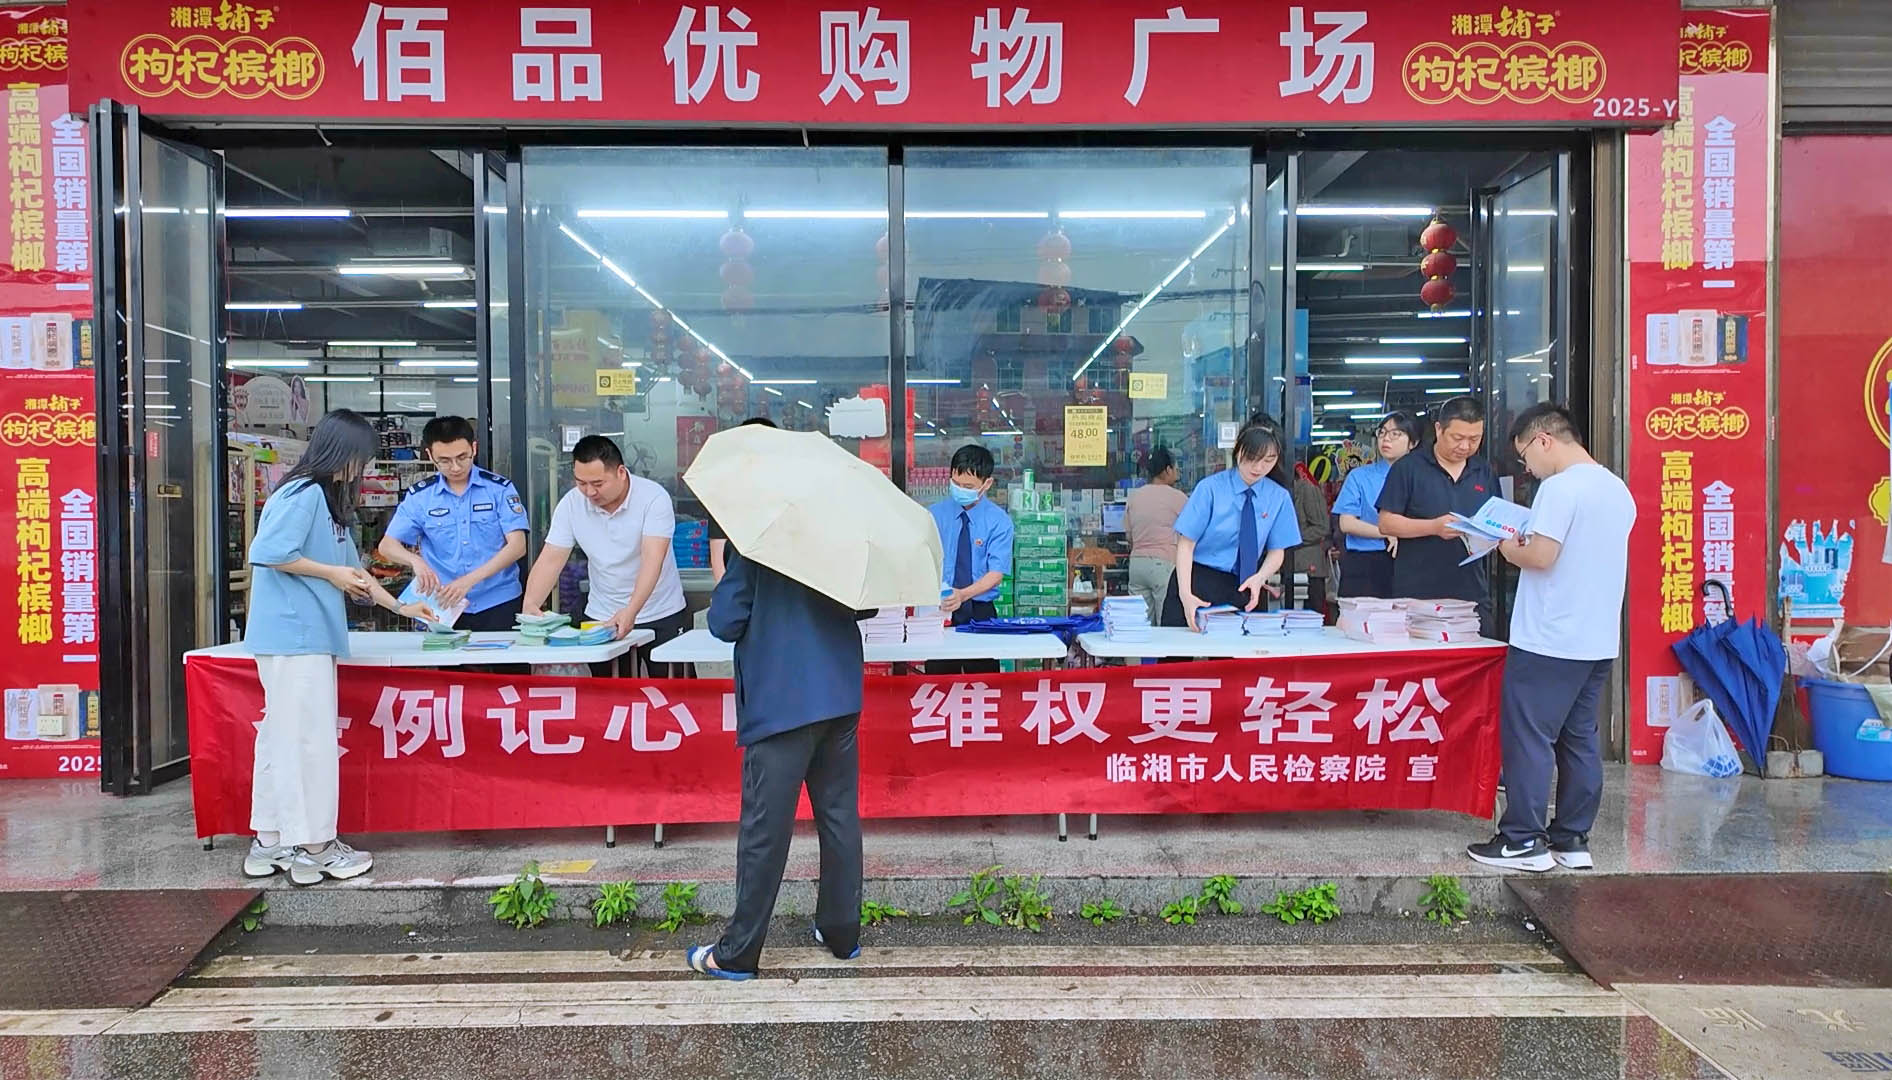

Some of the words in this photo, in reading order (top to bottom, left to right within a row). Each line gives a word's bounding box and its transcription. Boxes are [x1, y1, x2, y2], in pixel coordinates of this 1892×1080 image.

[129, 47, 316, 87] 枸杞槟榔
[352, 3, 1375, 107] 佰品优购物广场
[1411, 54, 1598, 92] 枸杞槟榔
[1593, 97, 1678, 118] 2025-Y
[8, 82, 45, 272] 高端枸杞槟榔
[51, 113, 91, 291] 全国销量第一
[1703, 115, 1737, 289] 全国销量第一
[1070, 427, 1099, 440] 48.00
[1650, 413, 1746, 434] 枸杞槟榔
[16, 457, 52, 644] 高端枸杞槟榔
[60, 488, 97, 663] 全国销量第一
[1660, 450, 1695, 633] 高端枸杞槟榔
[252, 684, 738, 758] 例记心
[909, 676, 1450, 748] 维权更轻松
[1105, 753, 1387, 784] 临湘市人民检察院
[1407, 754, 1438, 783] 宣
